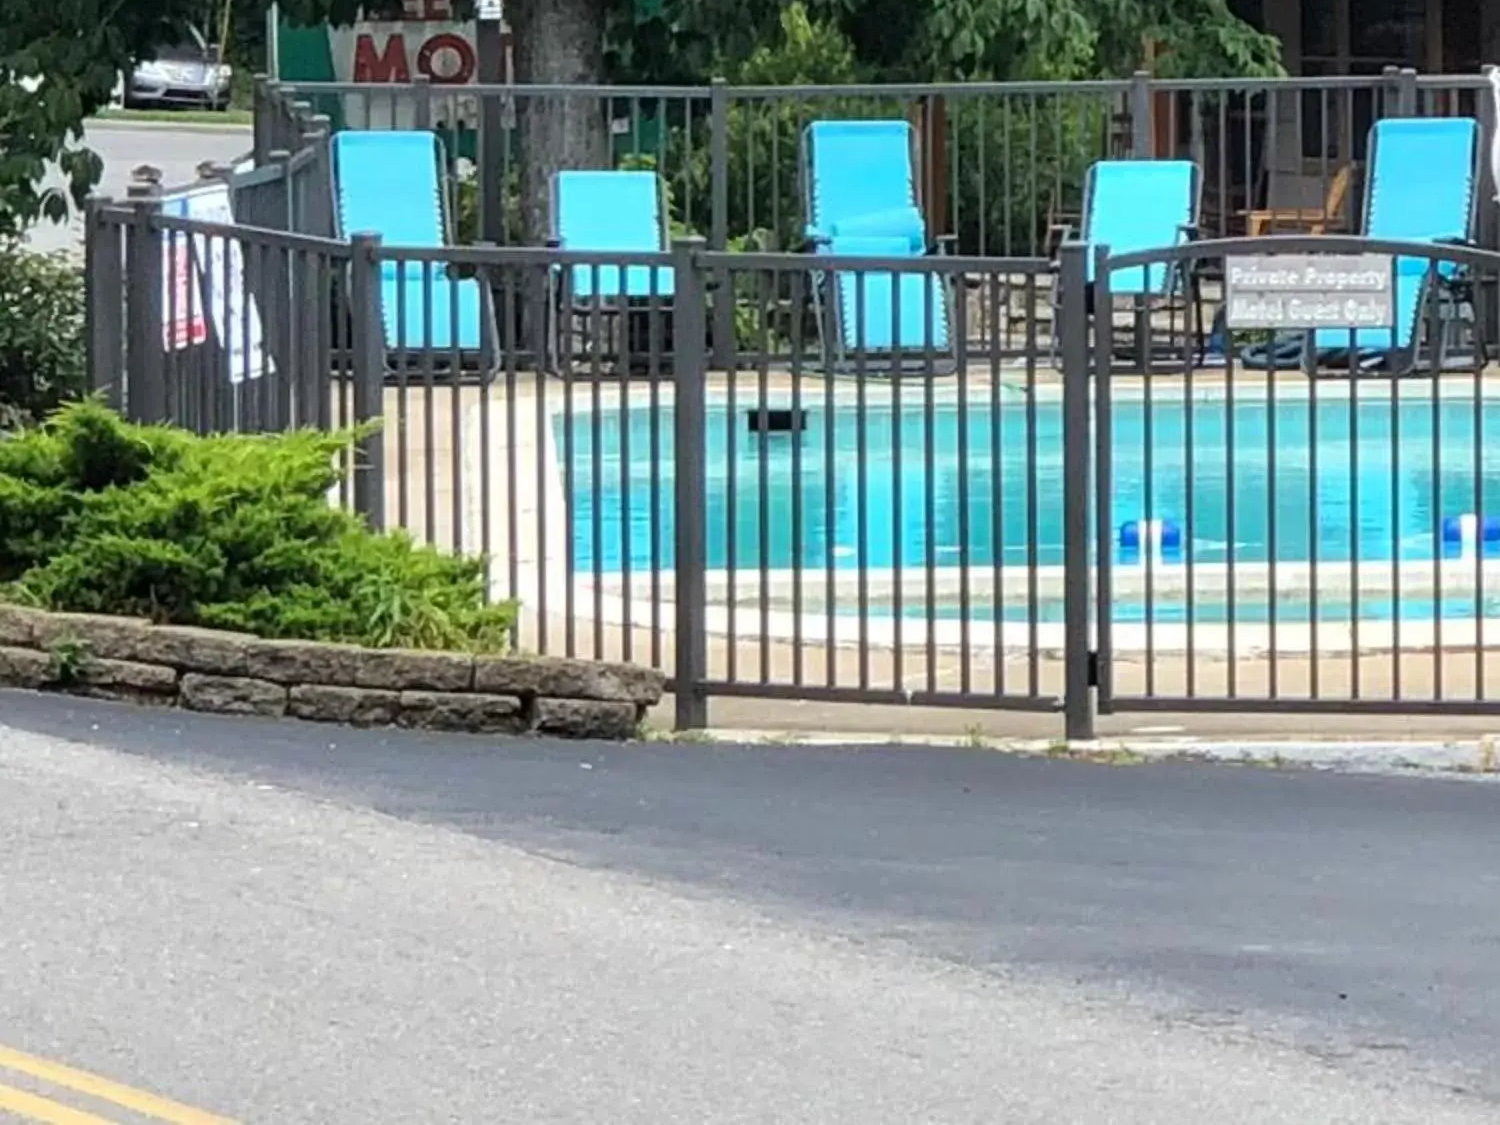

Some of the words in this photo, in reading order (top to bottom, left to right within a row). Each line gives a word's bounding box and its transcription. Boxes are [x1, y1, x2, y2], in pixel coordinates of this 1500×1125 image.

[1231, 266, 1299, 285] Private
[1305, 266, 1386, 290] Property
[1344, 299, 1386, 325] Only
